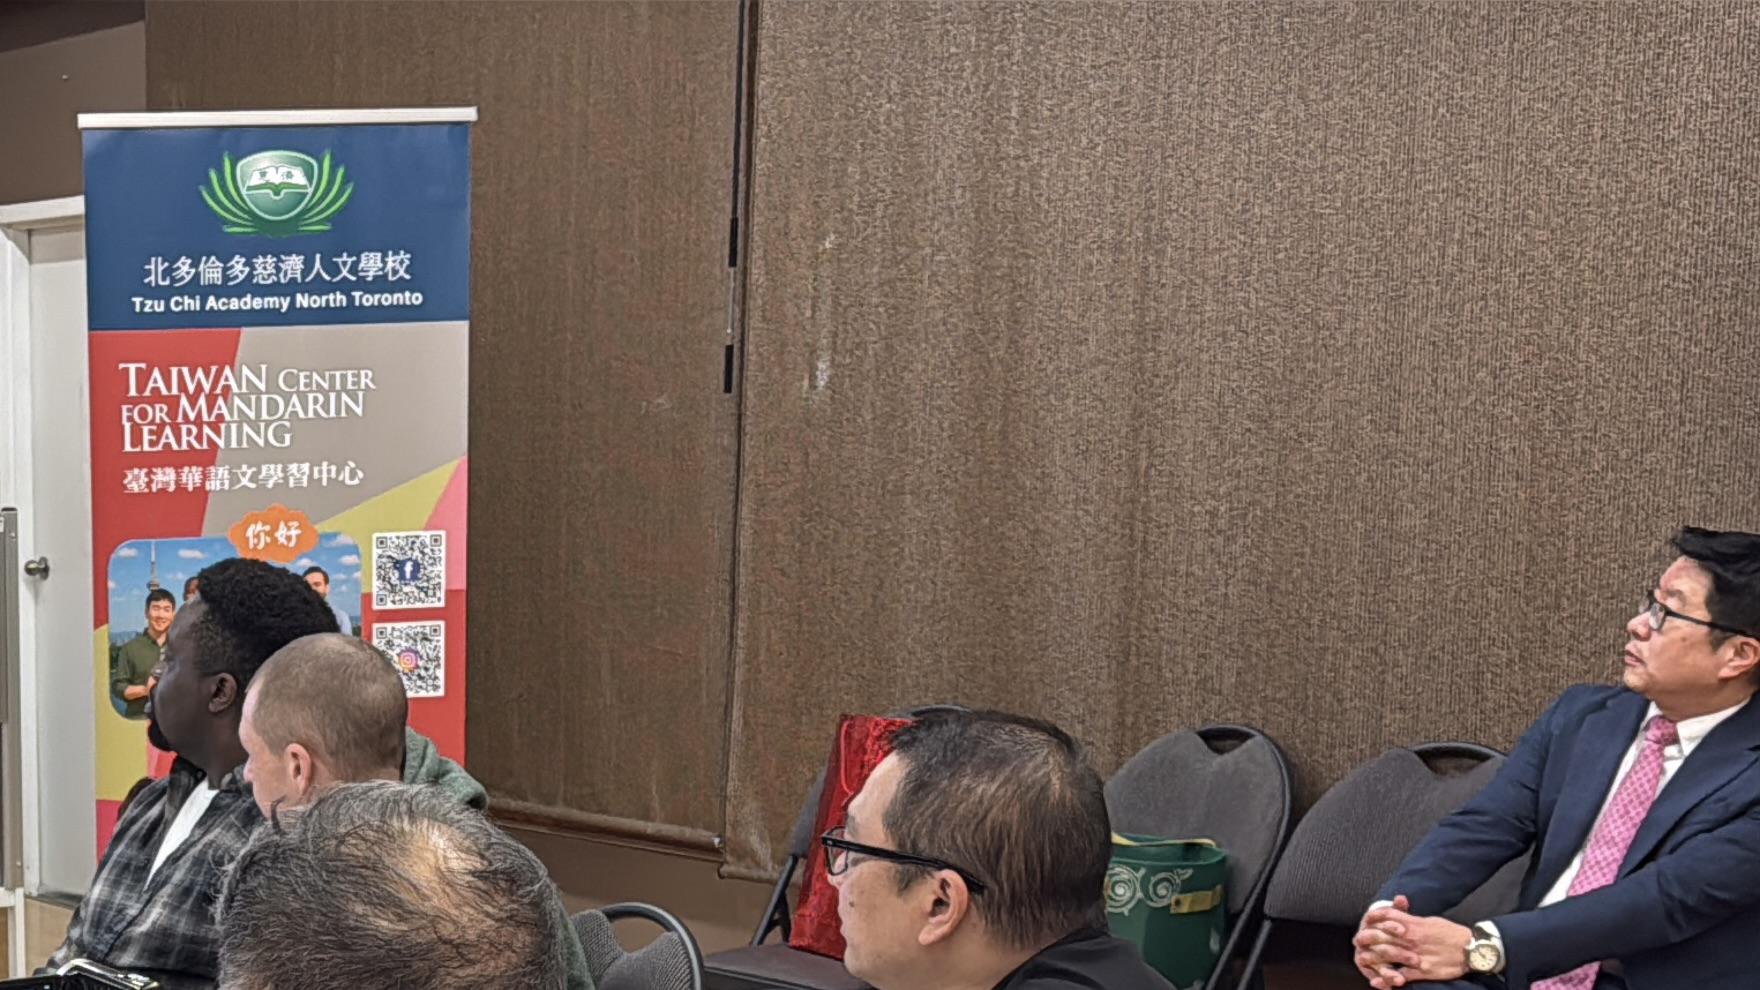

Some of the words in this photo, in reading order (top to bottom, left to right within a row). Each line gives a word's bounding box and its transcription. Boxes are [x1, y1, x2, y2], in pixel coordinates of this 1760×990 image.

[143, 250, 412, 287] 北多倫多慈濟人文學校
[132, 297, 164, 312] Tzu
[170, 295, 200, 311] Chi
[205, 294, 290, 312] Academy
[296, 291, 346, 308] North
[351, 291, 422, 306] Toronto
[119, 362, 267, 397] TAIWAN
[278, 369, 376, 392] CENTER
[121, 407, 170, 424] FOR
[176, 391, 364, 424] MANDARIN
[122, 420, 292, 453] LEARNING
[123, 461, 364, 494] 臺灣華語文學習中心
[246, 521, 302, 551] 你好
